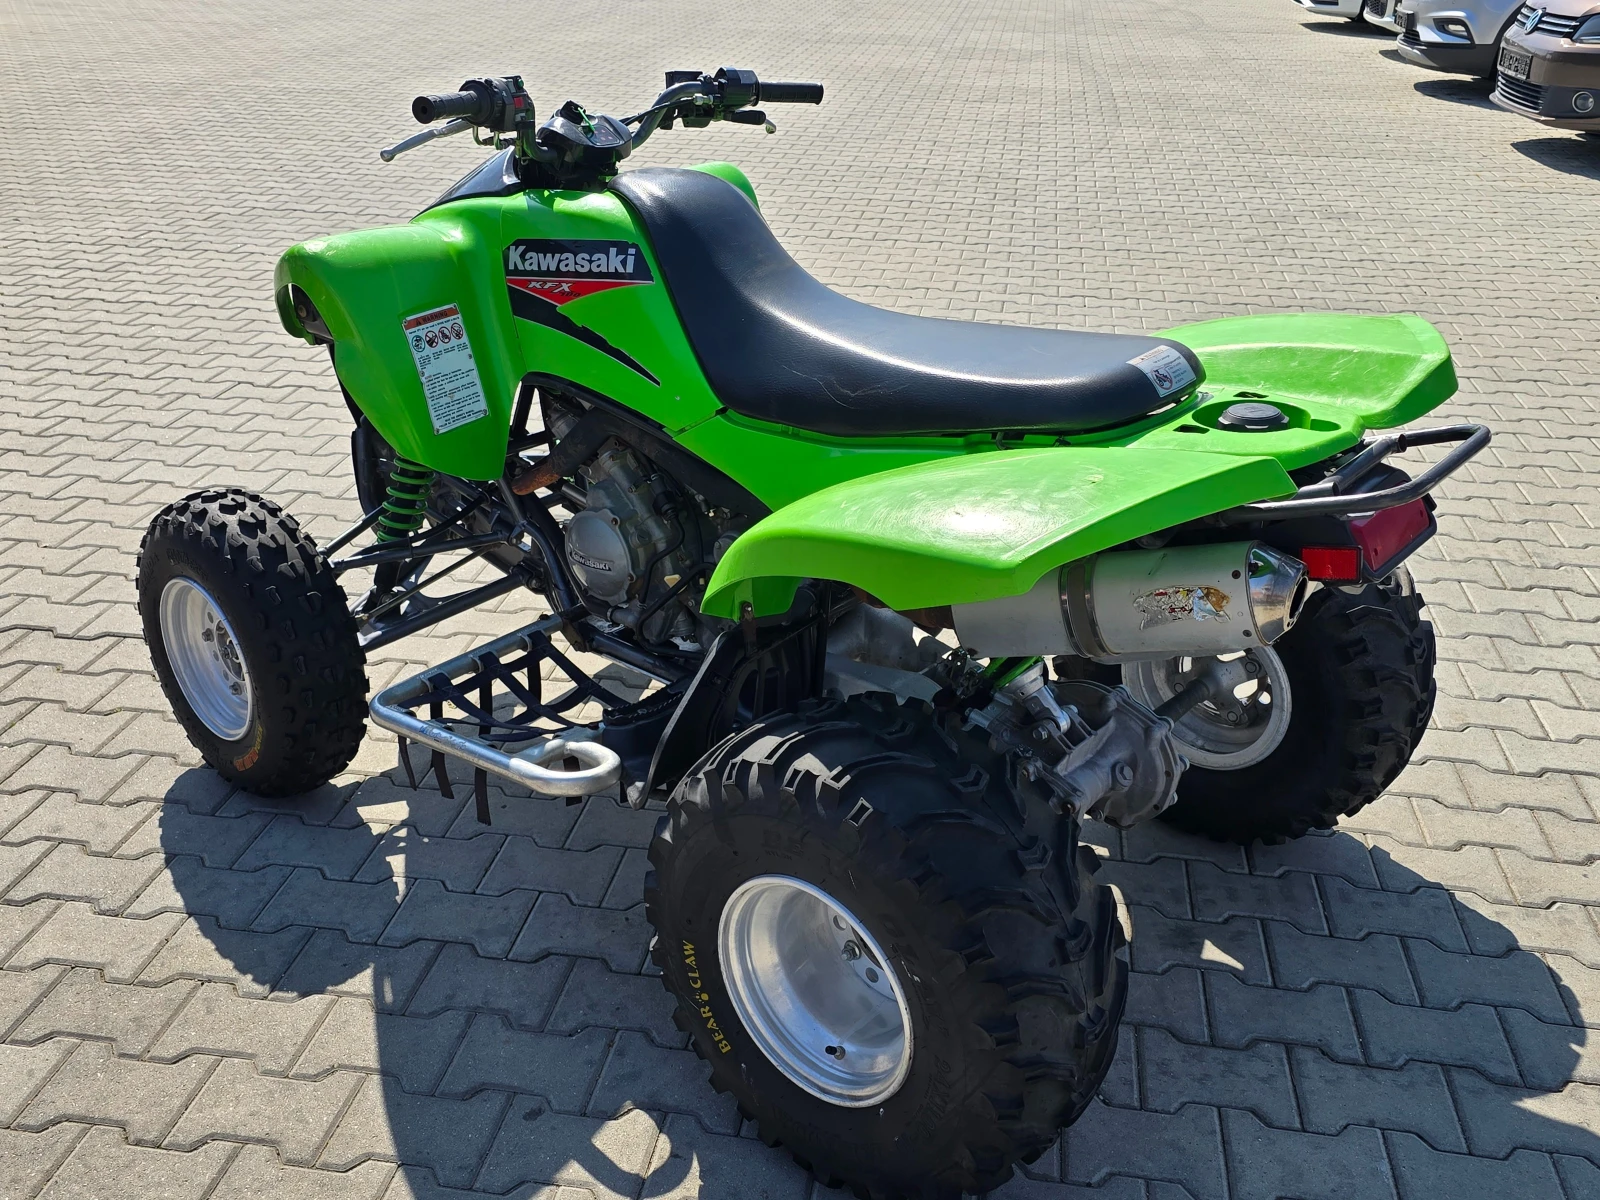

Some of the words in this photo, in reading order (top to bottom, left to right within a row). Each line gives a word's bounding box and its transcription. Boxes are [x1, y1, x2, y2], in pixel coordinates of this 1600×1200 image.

[508, 245, 636, 274] Kawasaki
[528, 281, 573, 292] KFX
[422, 310, 448, 325] WARNING
[571, 551, 609, 570] Kawasaki
[682, 939, 702, 989] CLAW
[700, 1005, 731, 1054] BEAR
